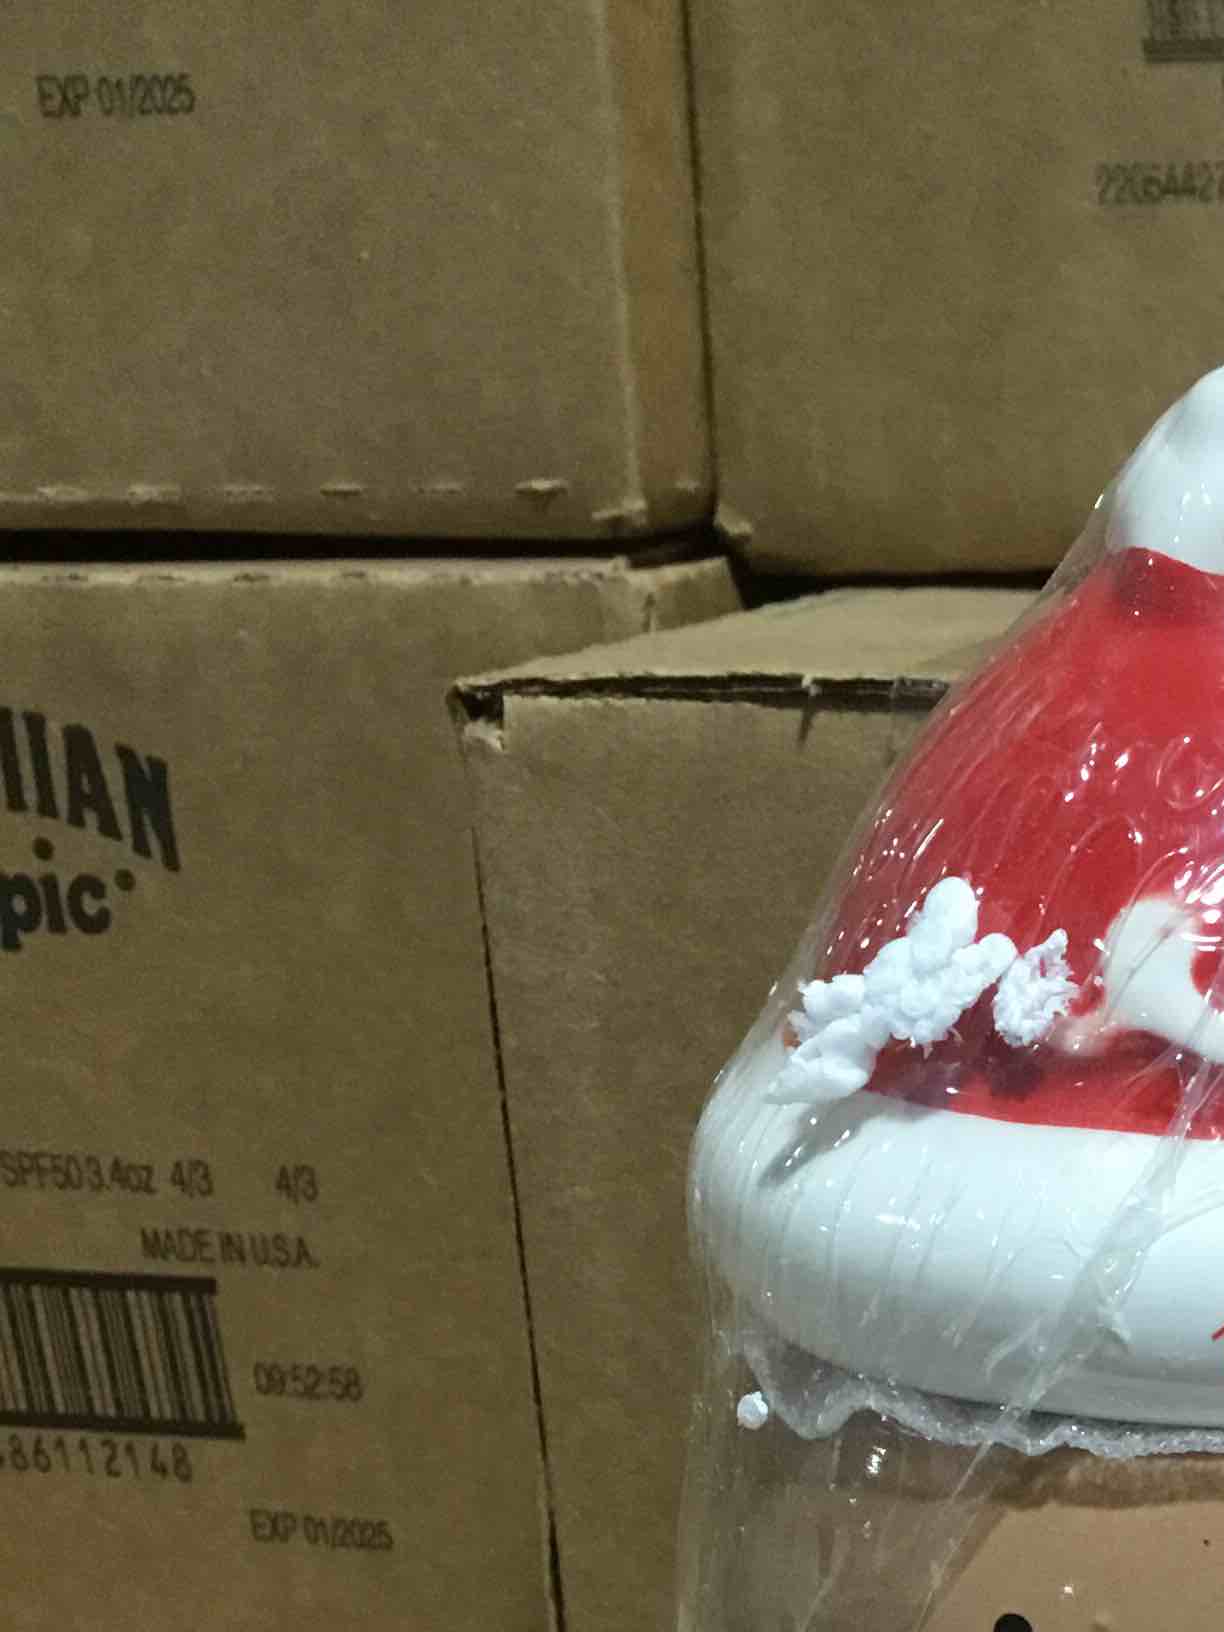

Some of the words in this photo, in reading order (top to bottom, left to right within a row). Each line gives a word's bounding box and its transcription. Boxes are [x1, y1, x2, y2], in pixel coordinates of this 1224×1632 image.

[36, 74, 90, 118] EXP
[140, 1226, 216, 1264] MADE
[219, 1231, 247, 1264] IN
[0, 1433, 192, 1482] 86112148
[249, 1508, 297, 1543] EXP
